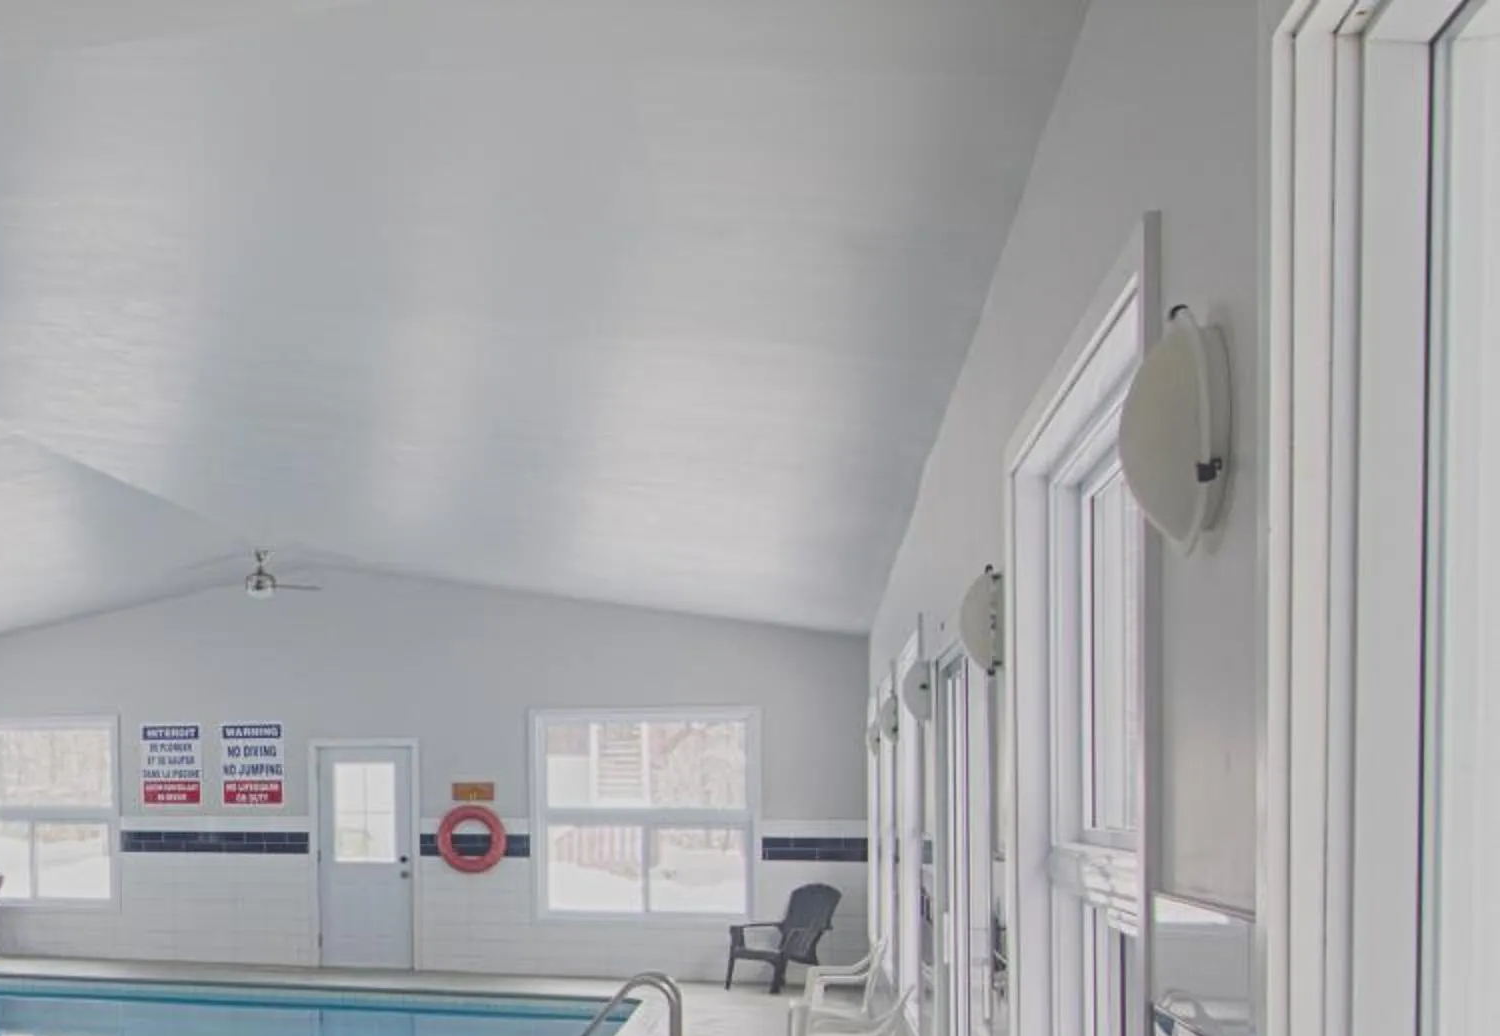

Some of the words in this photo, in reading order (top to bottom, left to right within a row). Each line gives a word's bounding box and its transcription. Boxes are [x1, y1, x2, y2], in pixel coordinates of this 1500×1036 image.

[226, 727, 278, 737] WARNING
[227, 746, 241, 757] NO
[243, 746, 276, 757] DIVING
[223, 764, 236, 775] NO
[239, 764, 282, 776] JUMPING
